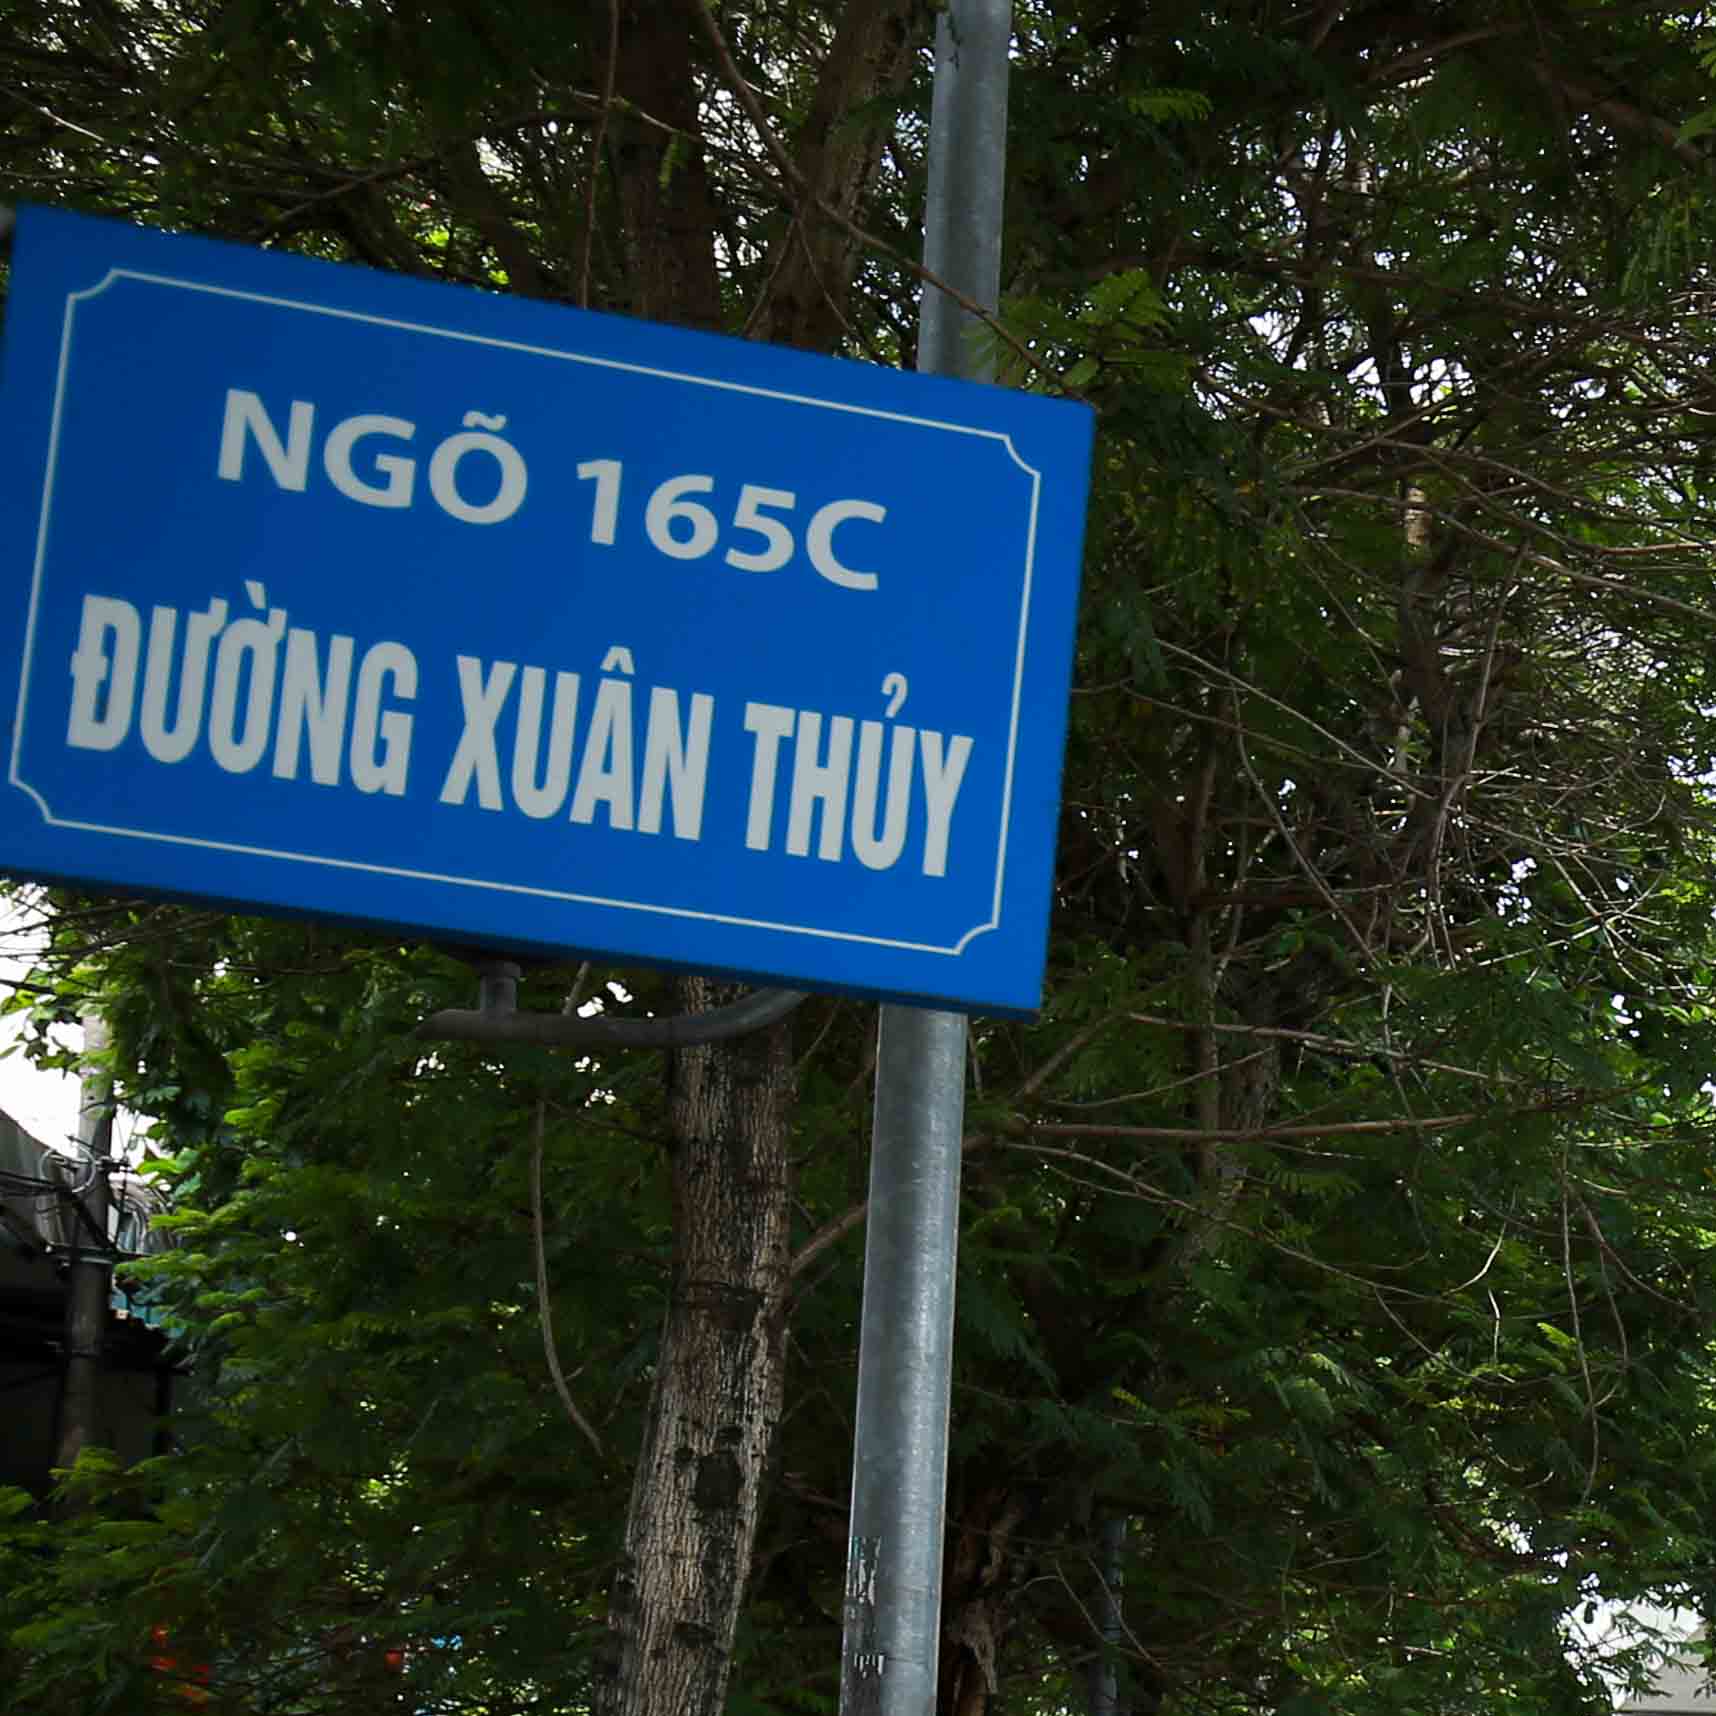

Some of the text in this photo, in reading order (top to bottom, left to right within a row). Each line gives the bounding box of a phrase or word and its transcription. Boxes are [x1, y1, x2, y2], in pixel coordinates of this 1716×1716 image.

[216, 387, 888, 591] NGÕ 165C
[66, 580, 975, 878] ĐƯỜNG XUÂN THỦY
